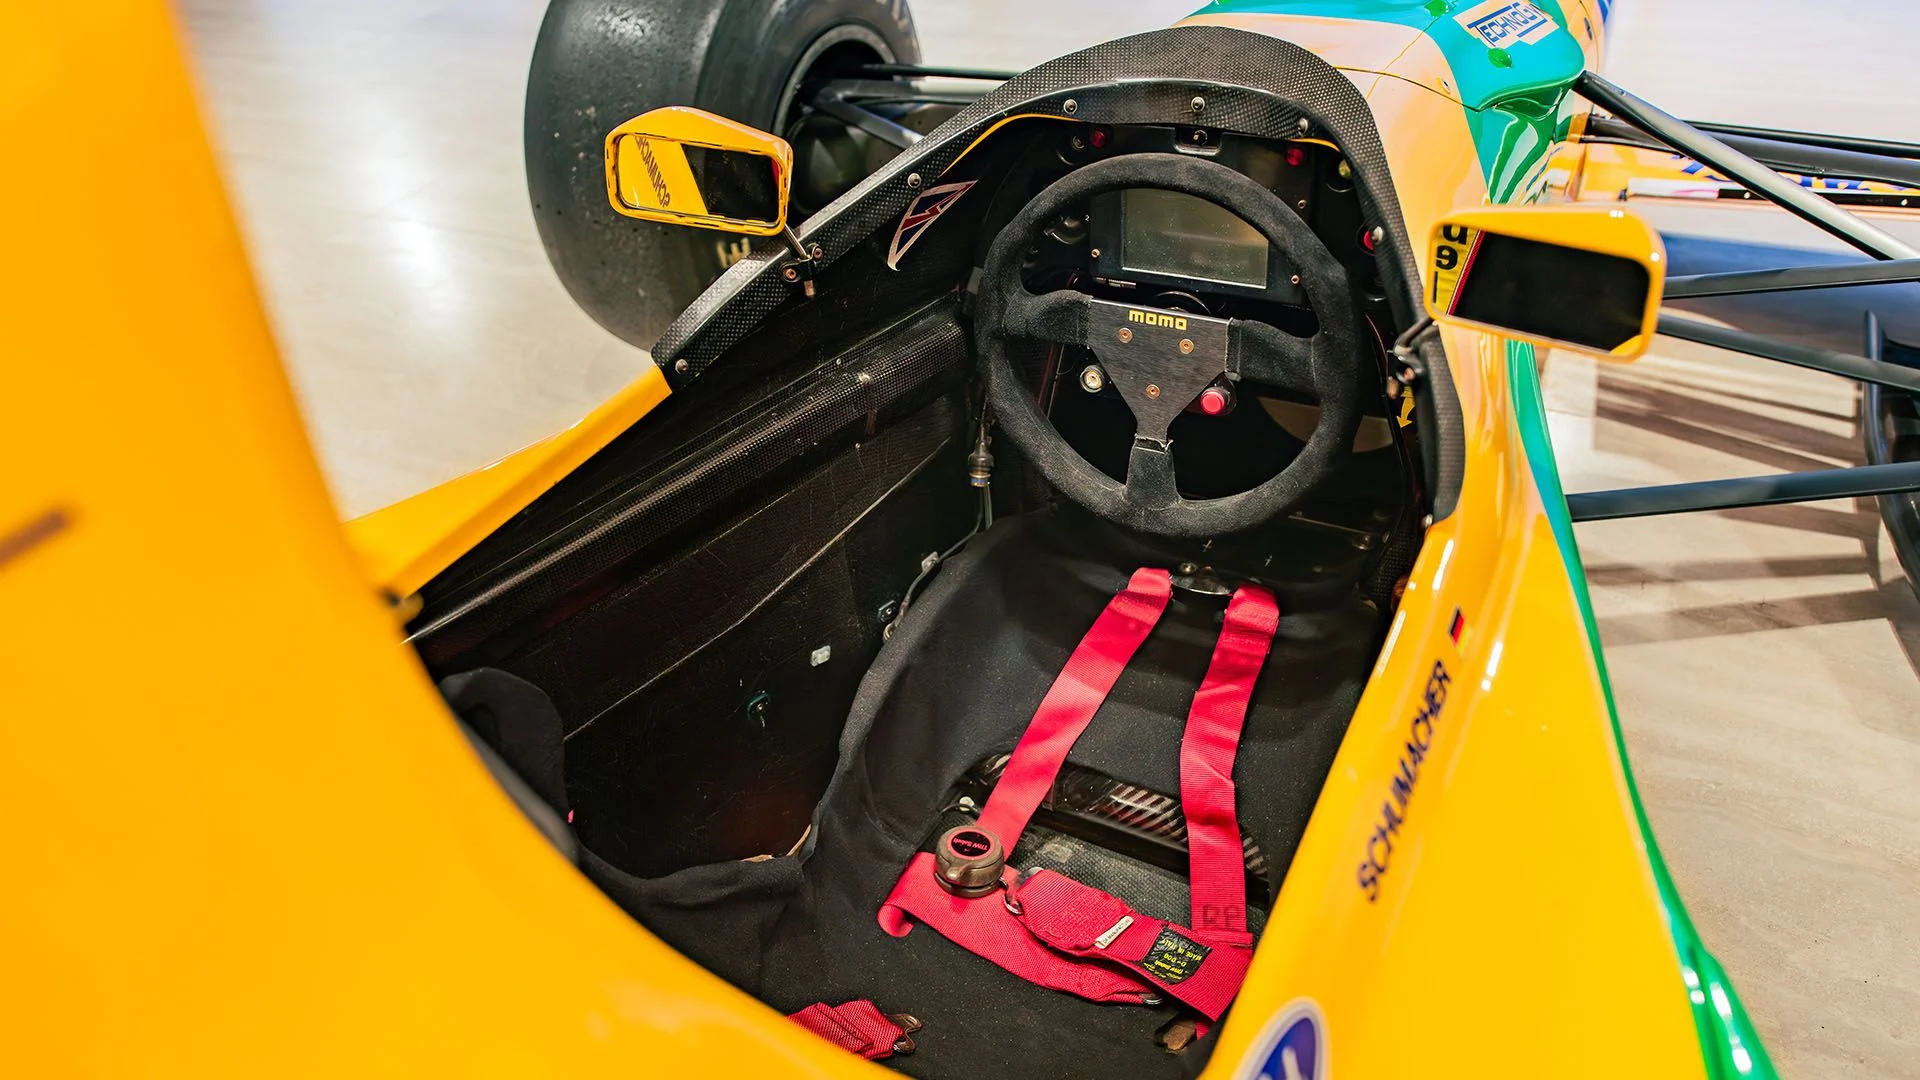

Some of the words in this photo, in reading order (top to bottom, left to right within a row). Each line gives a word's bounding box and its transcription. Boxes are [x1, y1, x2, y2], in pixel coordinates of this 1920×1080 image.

[1128, 309, 1188, 331] momo
[1357, 658, 1451, 903] SCHUMACHER
[1161, 938, 1178, 950] ITALY
[1185, 951, 1203, 961] MADE
